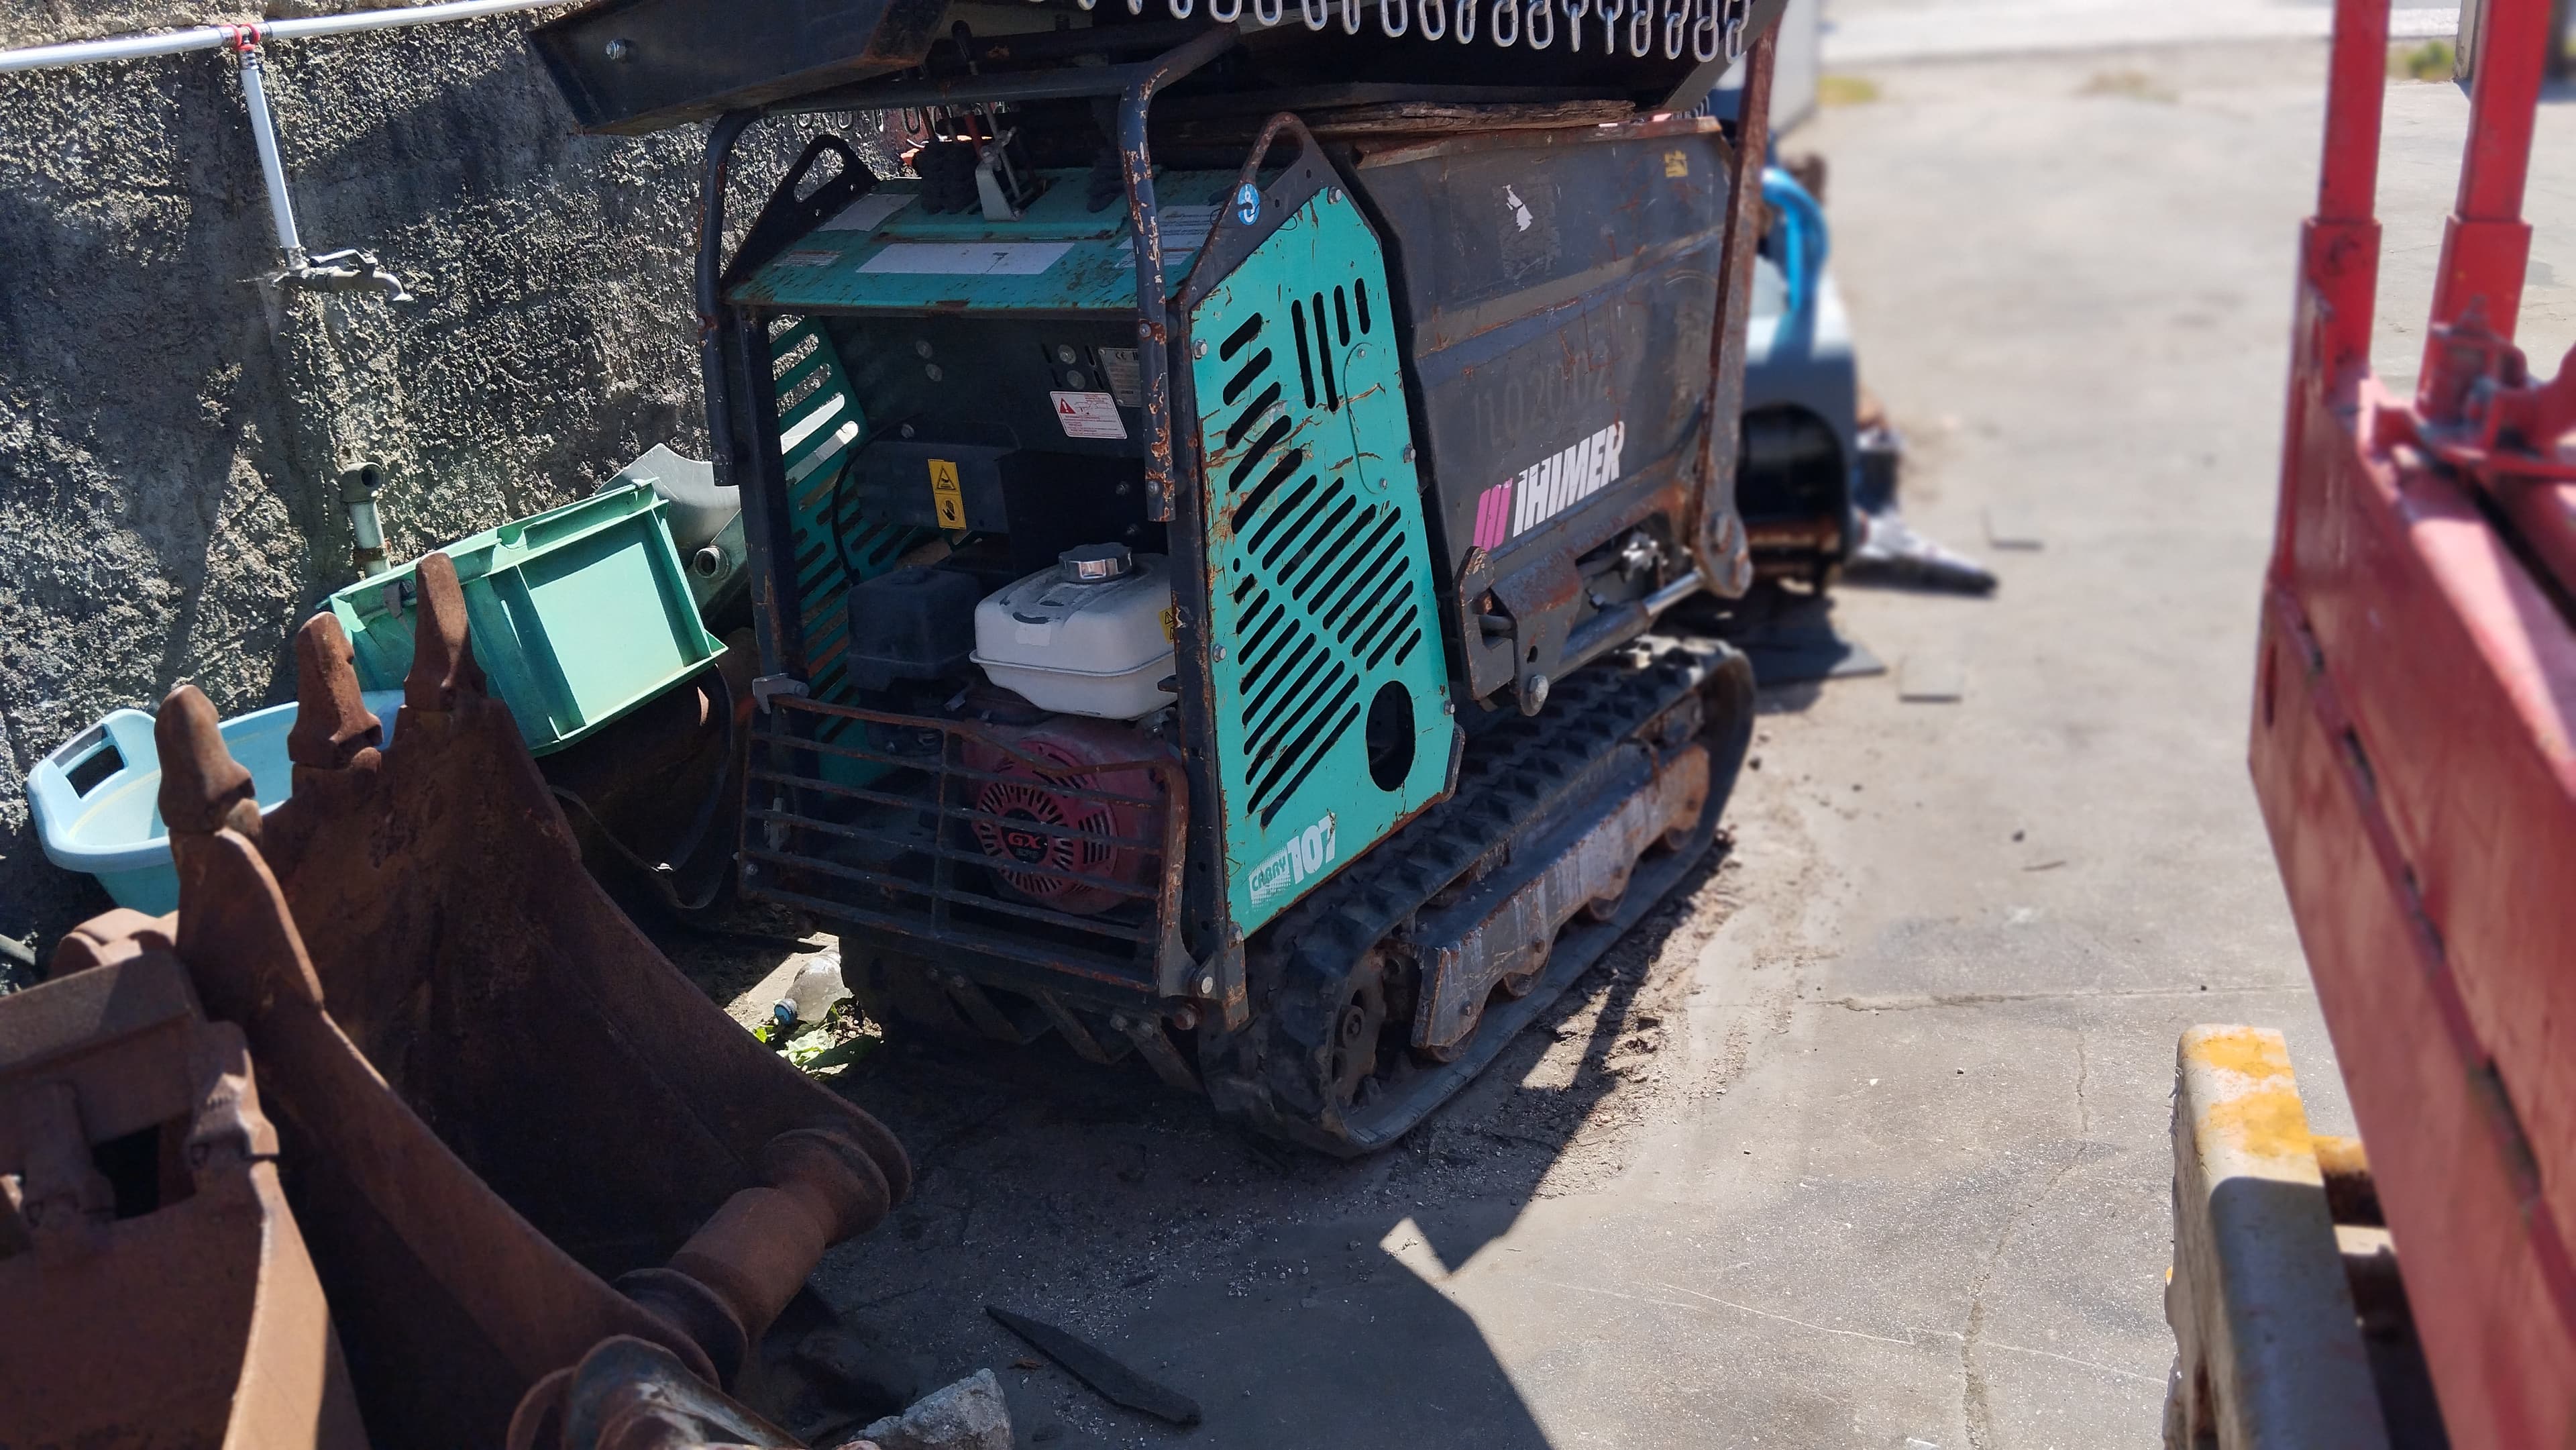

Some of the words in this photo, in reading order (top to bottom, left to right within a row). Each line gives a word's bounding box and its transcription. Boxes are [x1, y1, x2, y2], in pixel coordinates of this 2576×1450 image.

[1116, 352, 1127, 360] CE
[1513, 421, 1625, 537] IHIMER
[1008, 833, 1041, 849] GX
[1251, 856, 1287, 892] CARRY
[1287, 812, 1336, 884] 107
